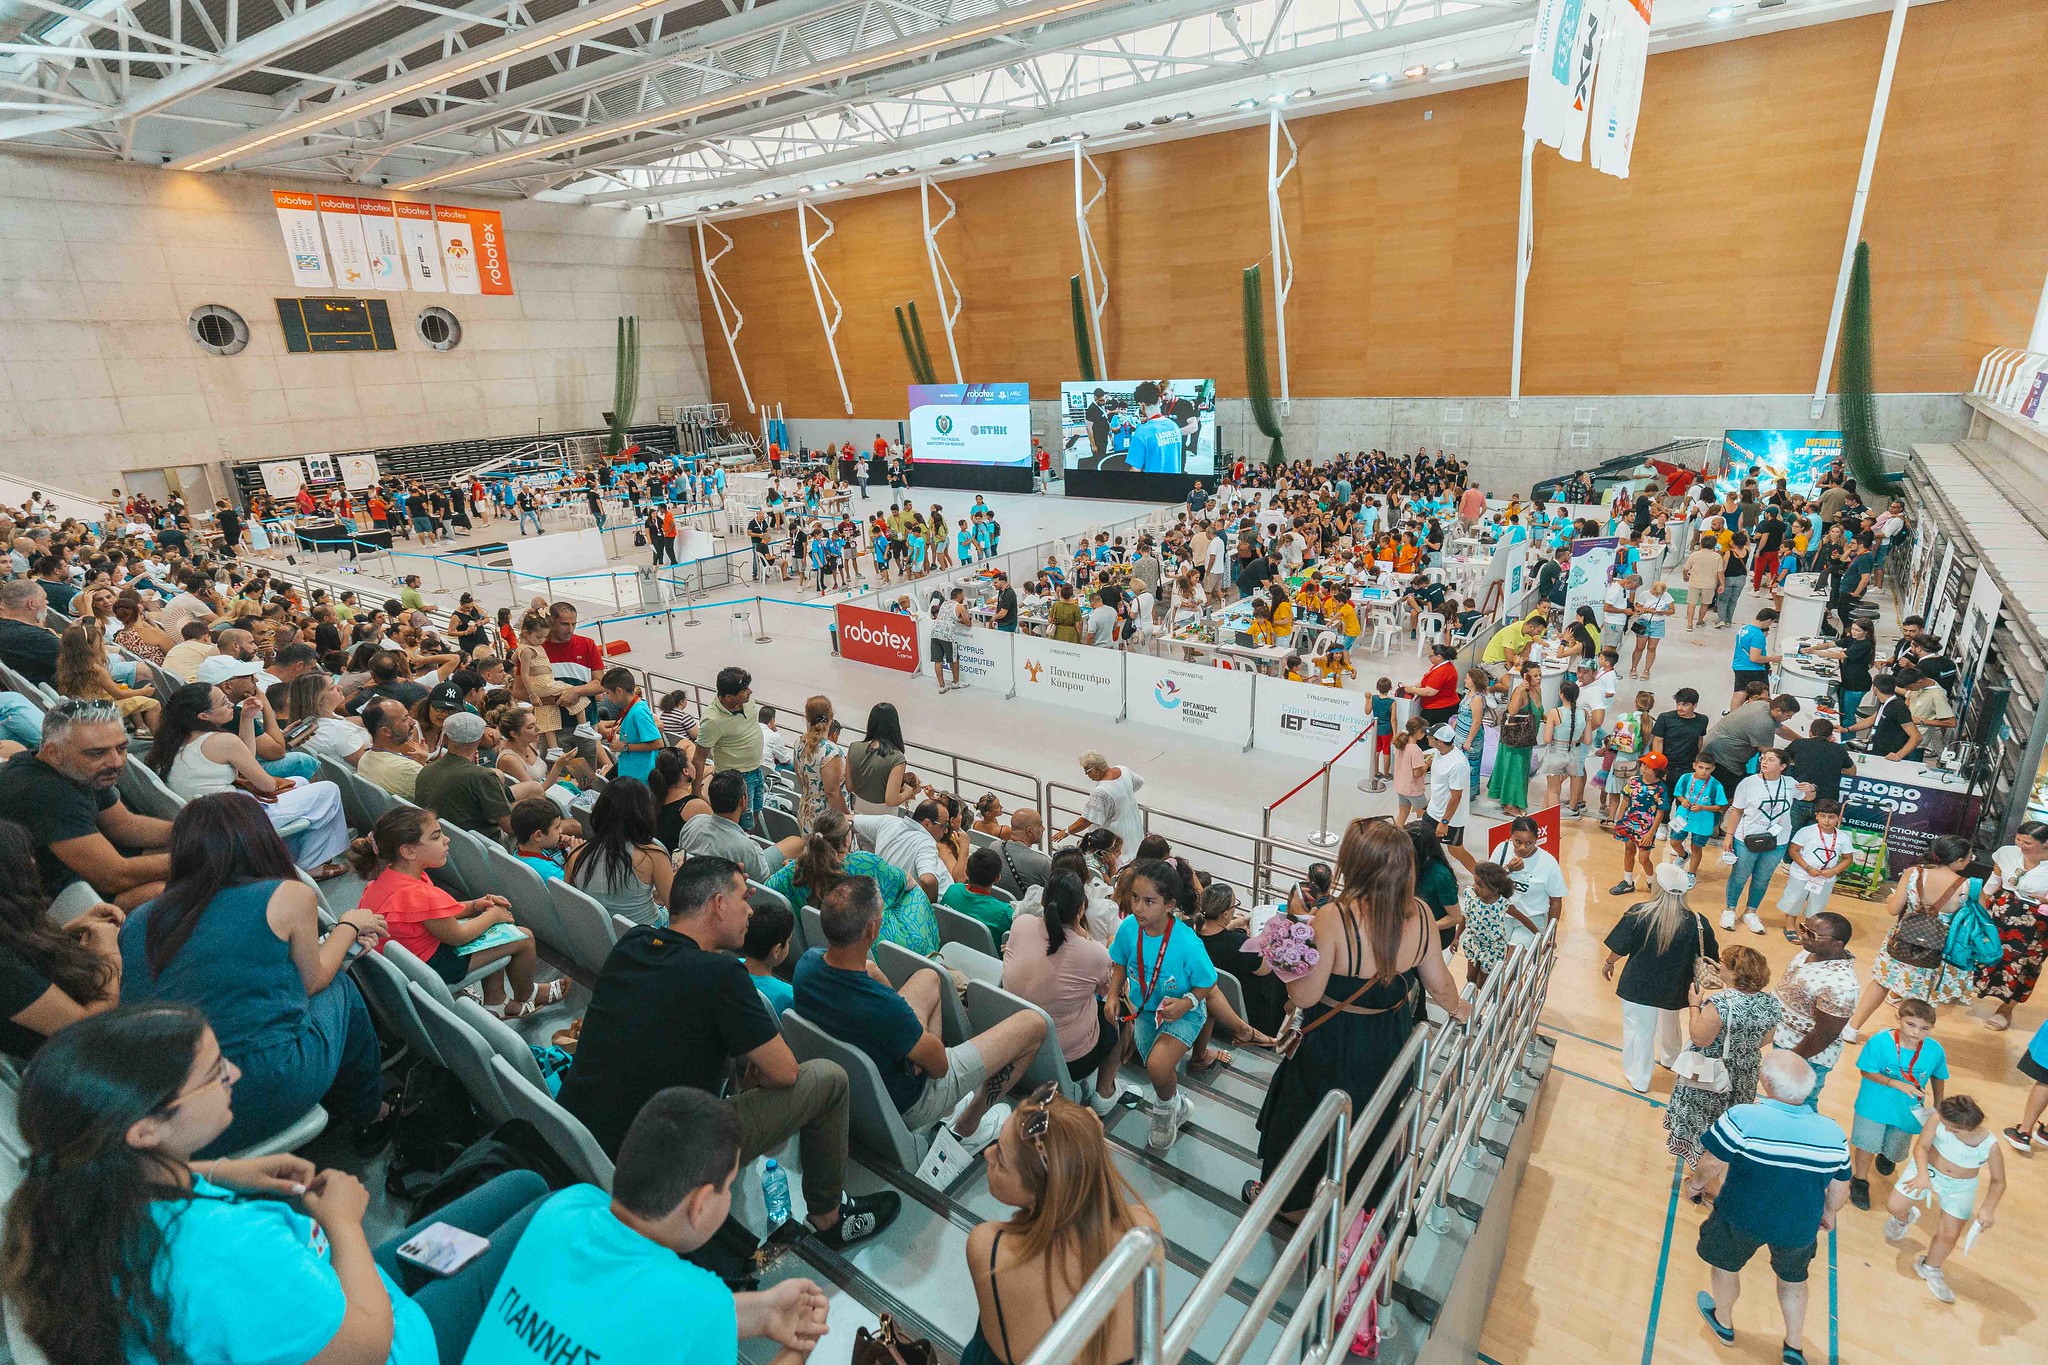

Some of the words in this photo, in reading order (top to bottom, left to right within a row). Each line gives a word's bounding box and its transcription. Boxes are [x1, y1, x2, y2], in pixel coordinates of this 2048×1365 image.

[278, 196, 312, 206] robotex
[321, 200, 355, 209] robotex
[360, 202, 391, 212] robotex
[398, 206, 430, 216] robotex
[437, 210, 467, 219] robotex
[482, 223, 502, 286] robotex
[967, 389, 994, 398] robotex
[1805, 438, 1842, 447] INFINITE
[1811, 448, 1841, 456] BEYOND
[844, 620, 912, 652] robotex
[958, 644, 984, 655] CYPRUS
[897, 651, 913, 660] Cyprus
[959, 655, 995, 667] COMPUTER
[959, 665, 987, 675] SOCIETY
[1050, 665, 1111, 686] Πανεπιστήμιο
[1050, 677, 1084, 692] Κύπρου
[1282, 703, 1310, 716] Cyprus
[1313, 709, 1336, 720] Local
[1339, 713, 1373, 725] Networ
[1280, 713, 1308, 731] IET
[1858, 780, 1921, 801] ROBO
[1839, 790, 1918, 815] TSTOP
[1848, 819, 1919, 836] RESURRCTION
[1921, 832, 1942, 840] ZON
[1897, 848, 1915, 856] CODE
